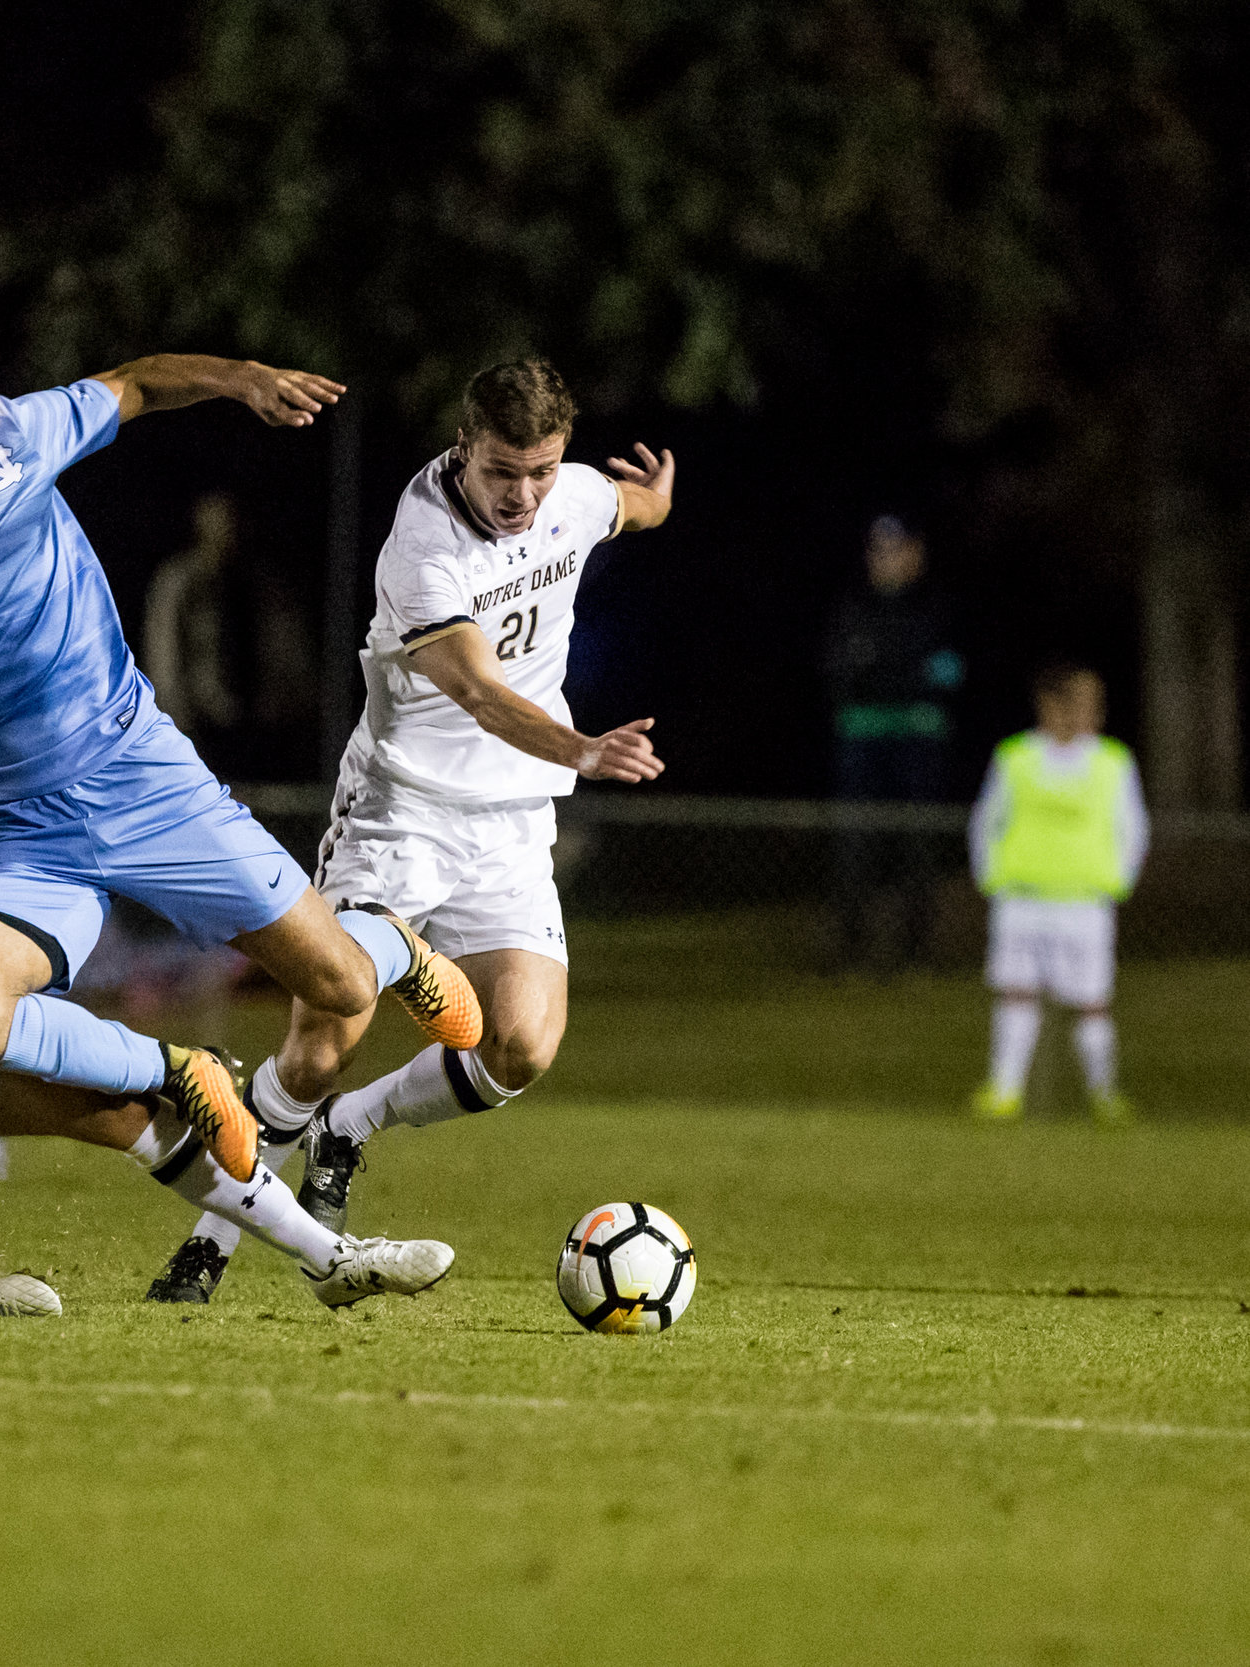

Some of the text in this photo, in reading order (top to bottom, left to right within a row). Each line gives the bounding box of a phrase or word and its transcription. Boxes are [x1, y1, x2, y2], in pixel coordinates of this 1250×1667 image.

[472, 550, 577, 617] NOTRE DAME
[496, 604, 538, 661] 21
